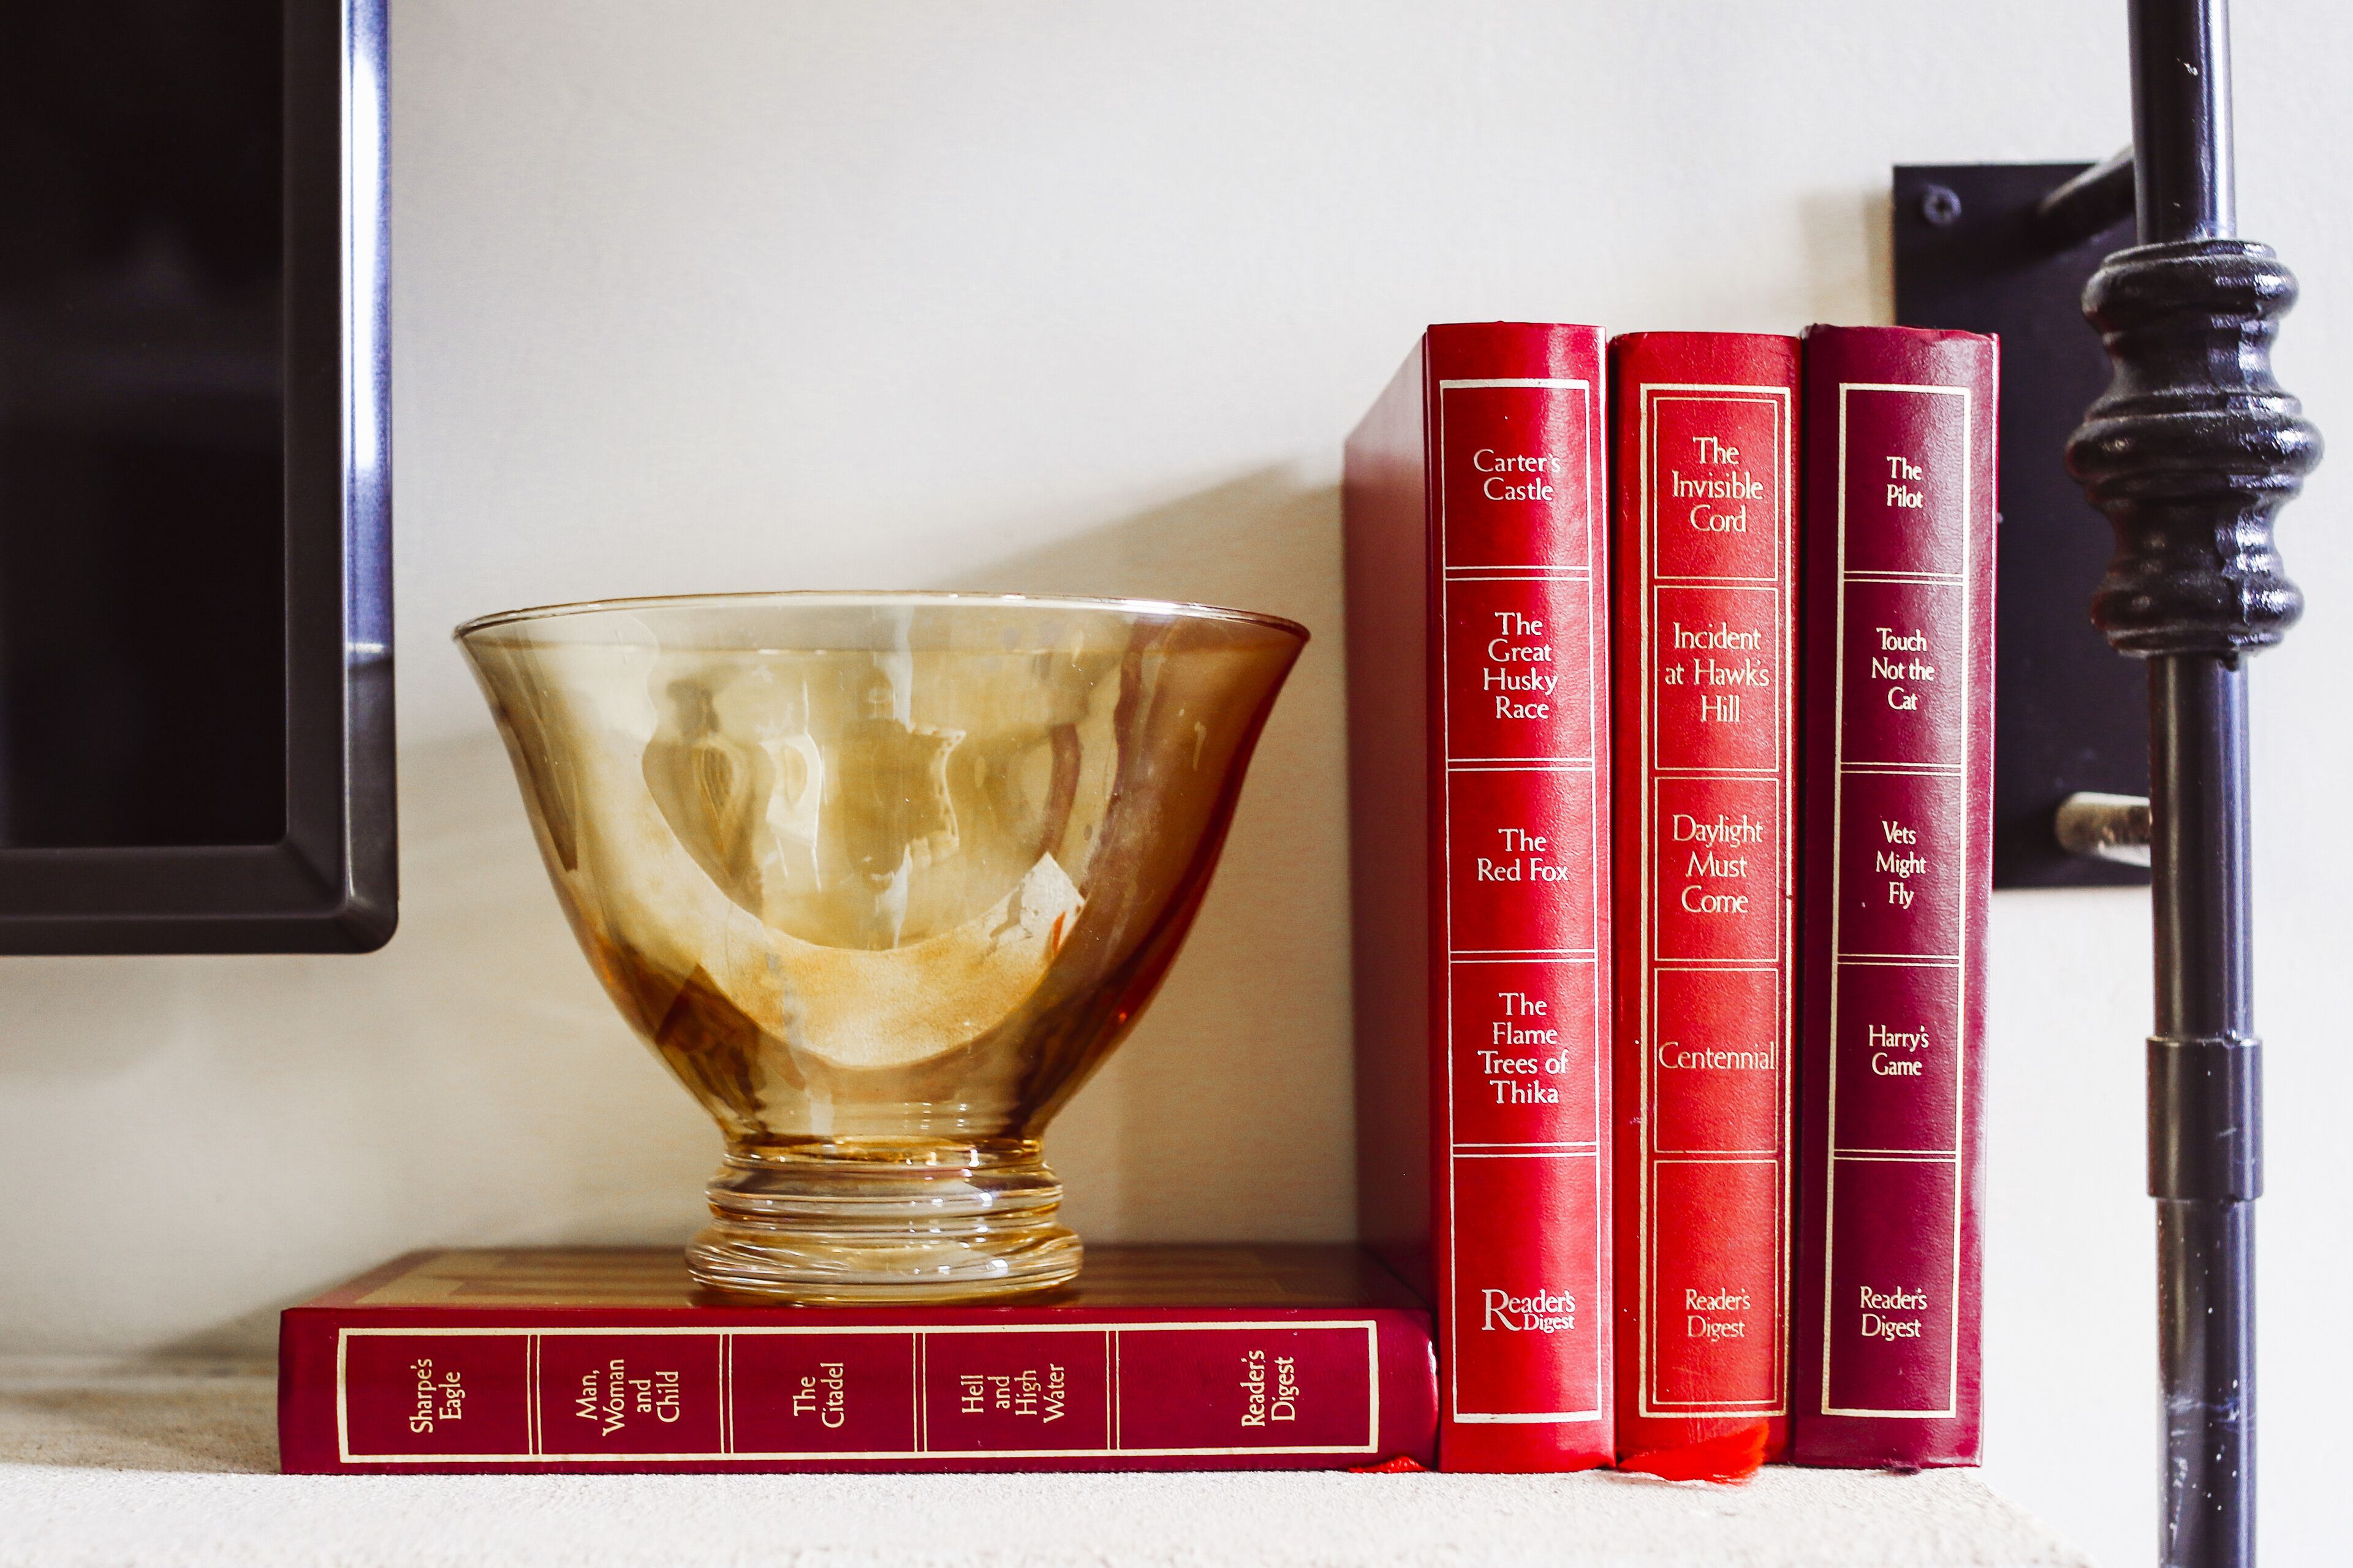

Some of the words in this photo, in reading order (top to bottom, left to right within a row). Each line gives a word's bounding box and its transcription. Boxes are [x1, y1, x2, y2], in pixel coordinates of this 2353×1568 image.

[1473, 449, 1561, 473] Carter's
[1693, 436, 1740, 465] The
[1887, 456, 1922, 480] The
[1483, 477, 1553, 501] Castle
[1673, 471, 1764, 500] Invisible
[1887, 485, 1923, 509] Pilot
[1690, 505, 1746, 533] Cord
[1495, 612, 1543, 635] The
[1673, 622, 1762, 650] Incident
[1487, 639, 1552, 662] Great
[1876, 627, 1927, 651] Touch
[1483, 668, 1558, 695] Husky
[1665, 664, 1684, 685] at
[1694, 659, 1770, 687] Hawk's
[1871, 657, 1906, 680] Not
[1909, 662, 1935, 681] the
[1496, 696, 1548, 719] Race
[1701, 695, 1740, 722] Hill
[1887, 686, 1918, 711] Cat
[1498, 829, 1547, 852] The
[1672, 814, 1764, 848] Daylight
[1882, 821, 1917, 845] Vets
[1477, 858, 1521, 881] Red
[1530, 858, 1569, 882] Fox
[1686, 851, 1748, 877] Must
[1876, 851, 1927, 879] Might
[1681, 885, 1749, 914] Come
[1889, 881, 1914, 909] Fly
[1498, 993, 1547, 1016] The
[1493, 1022, 1558, 1045] Flame
[1868, 1025, 1929, 1051] Harry's
[1477, 1050, 1537, 1074] Trees
[1545, 1049, 1569, 1074] of
[1658, 1042, 1776, 1070] Centennial
[1871, 1052, 1922, 1076] Game
[1490, 1080, 1559, 1104] Thika
[1482, 1288, 1575, 1331] Reader's
[1685, 1288, 1751, 1312] Reader's
[1860, 1286, 1928, 1311] Reader's
[1523, 1312, 1575, 1334] Digest
[1687, 1316, 1746, 1342] Digest
[1860, 1314, 1921, 1342] Digest
[410, 1358, 438, 1433] Sharpe's
[439, 1372, 466, 1420] Eagle
[576, 1369, 599, 1420] Man,
[602, 1359, 625, 1436] Woman
[629, 1379, 651, 1413] and
[656, 1371, 680, 1423] Child
[793, 1376, 816, 1416] The
[820, 1363, 844, 1428] Citadel
[961, 1375, 984, 1414] Hell
[987, 1376, 1010, 1409] and
[1015, 1369, 1041, 1415] High
[1043, 1364, 1064, 1423] Water
[1240, 1350, 1265, 1427] Reader's
[1271, 1357, 1300, 1422] Digest
